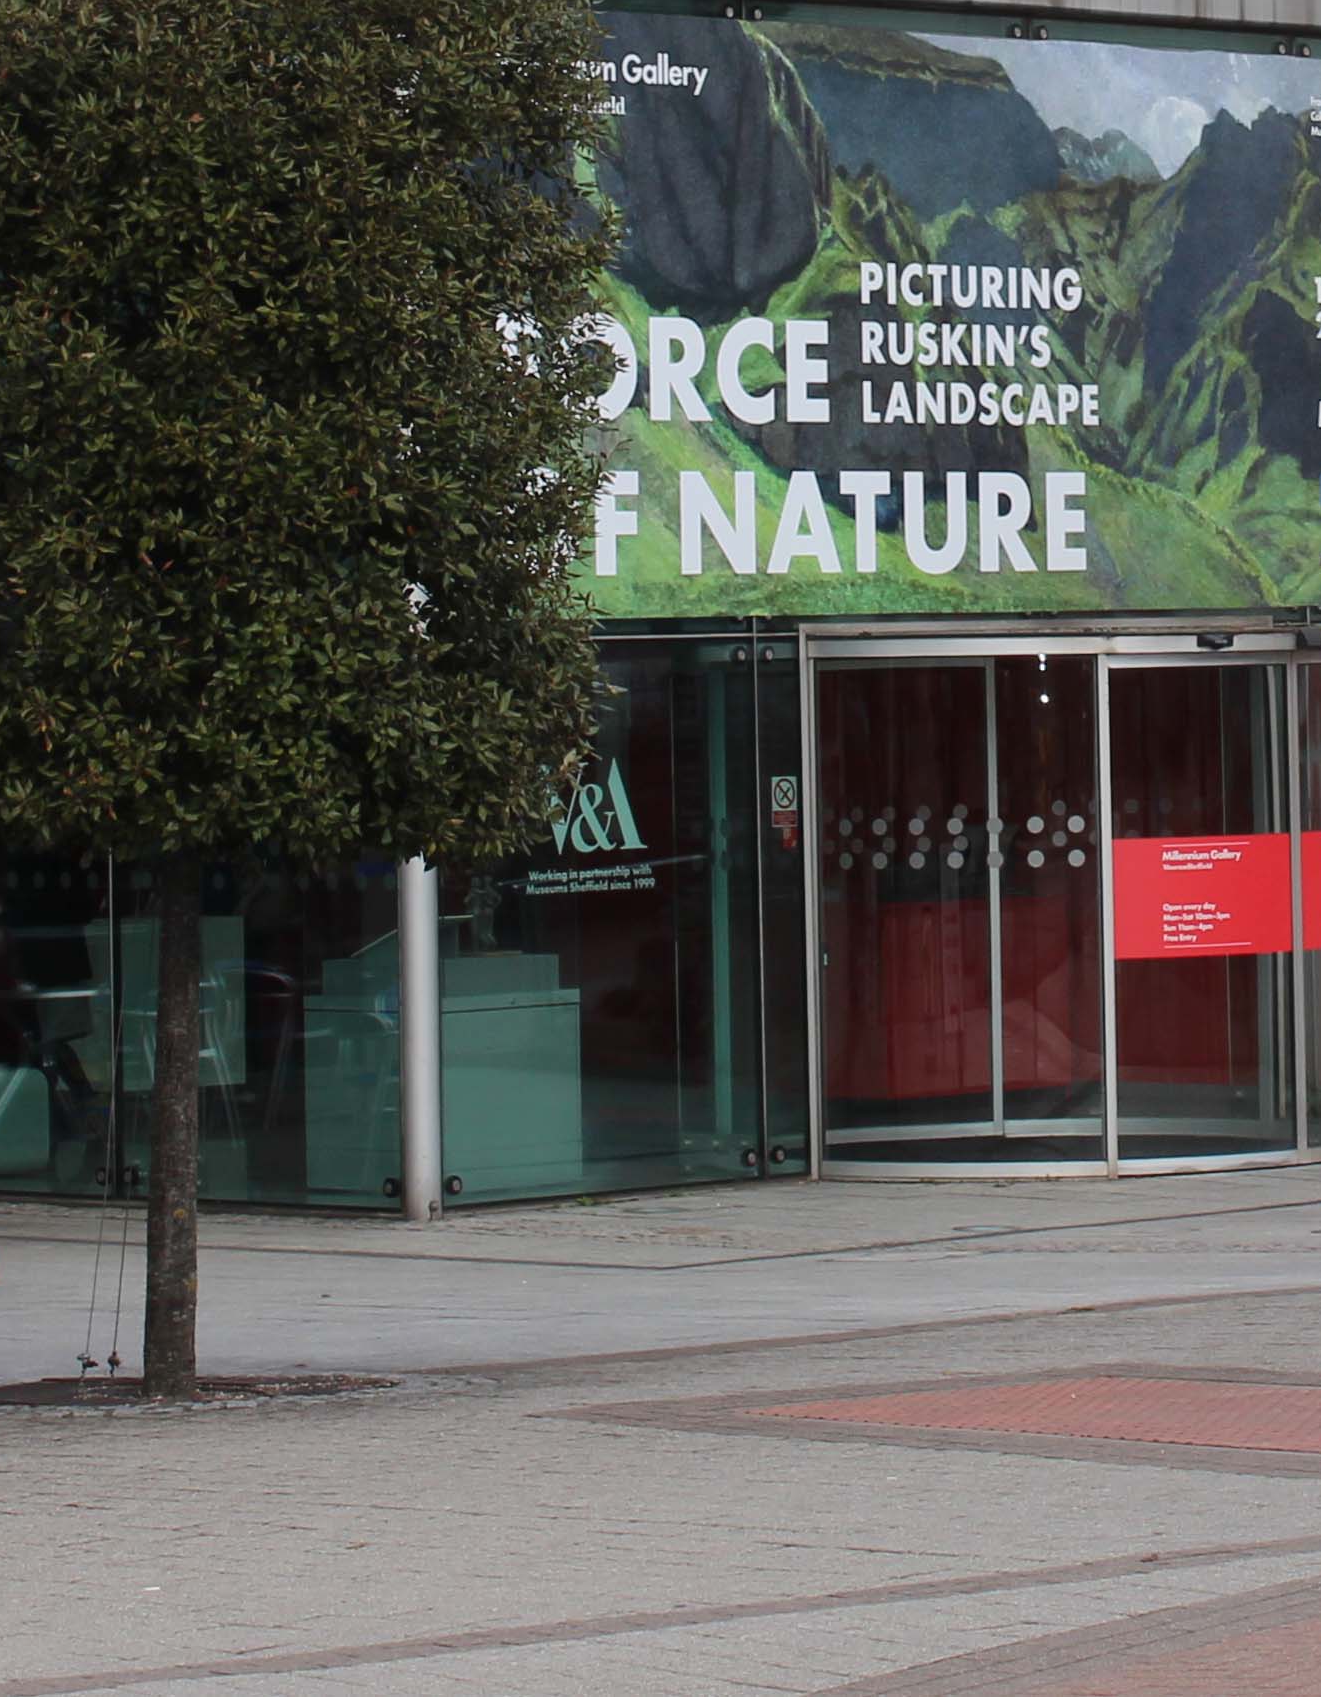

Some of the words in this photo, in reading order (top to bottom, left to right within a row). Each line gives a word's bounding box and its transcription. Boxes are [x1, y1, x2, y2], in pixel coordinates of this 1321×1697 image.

[621, 52, 709, 97] Gallery
[860, 261, 1083, 312] PICTURING
[496, 310, 830, 425] ORCE
[861, 320, 1052, 368] RUSKIN'S
[862, 380, 1100, 427] LANDSCAPE
[680, 466, 1089, 577] NATURE
[526, 884, 568, 895] Museums
[569, 880, 609, 893] Sheffield
[610, 879, 632, 890] since
[633, 878, 656, 889] 1999
[528, 870, 568, 882] Working
[569, 869, 578, 880] in
[579, 865, 631, 880] partnership
[632, 864, 652, 876] with
